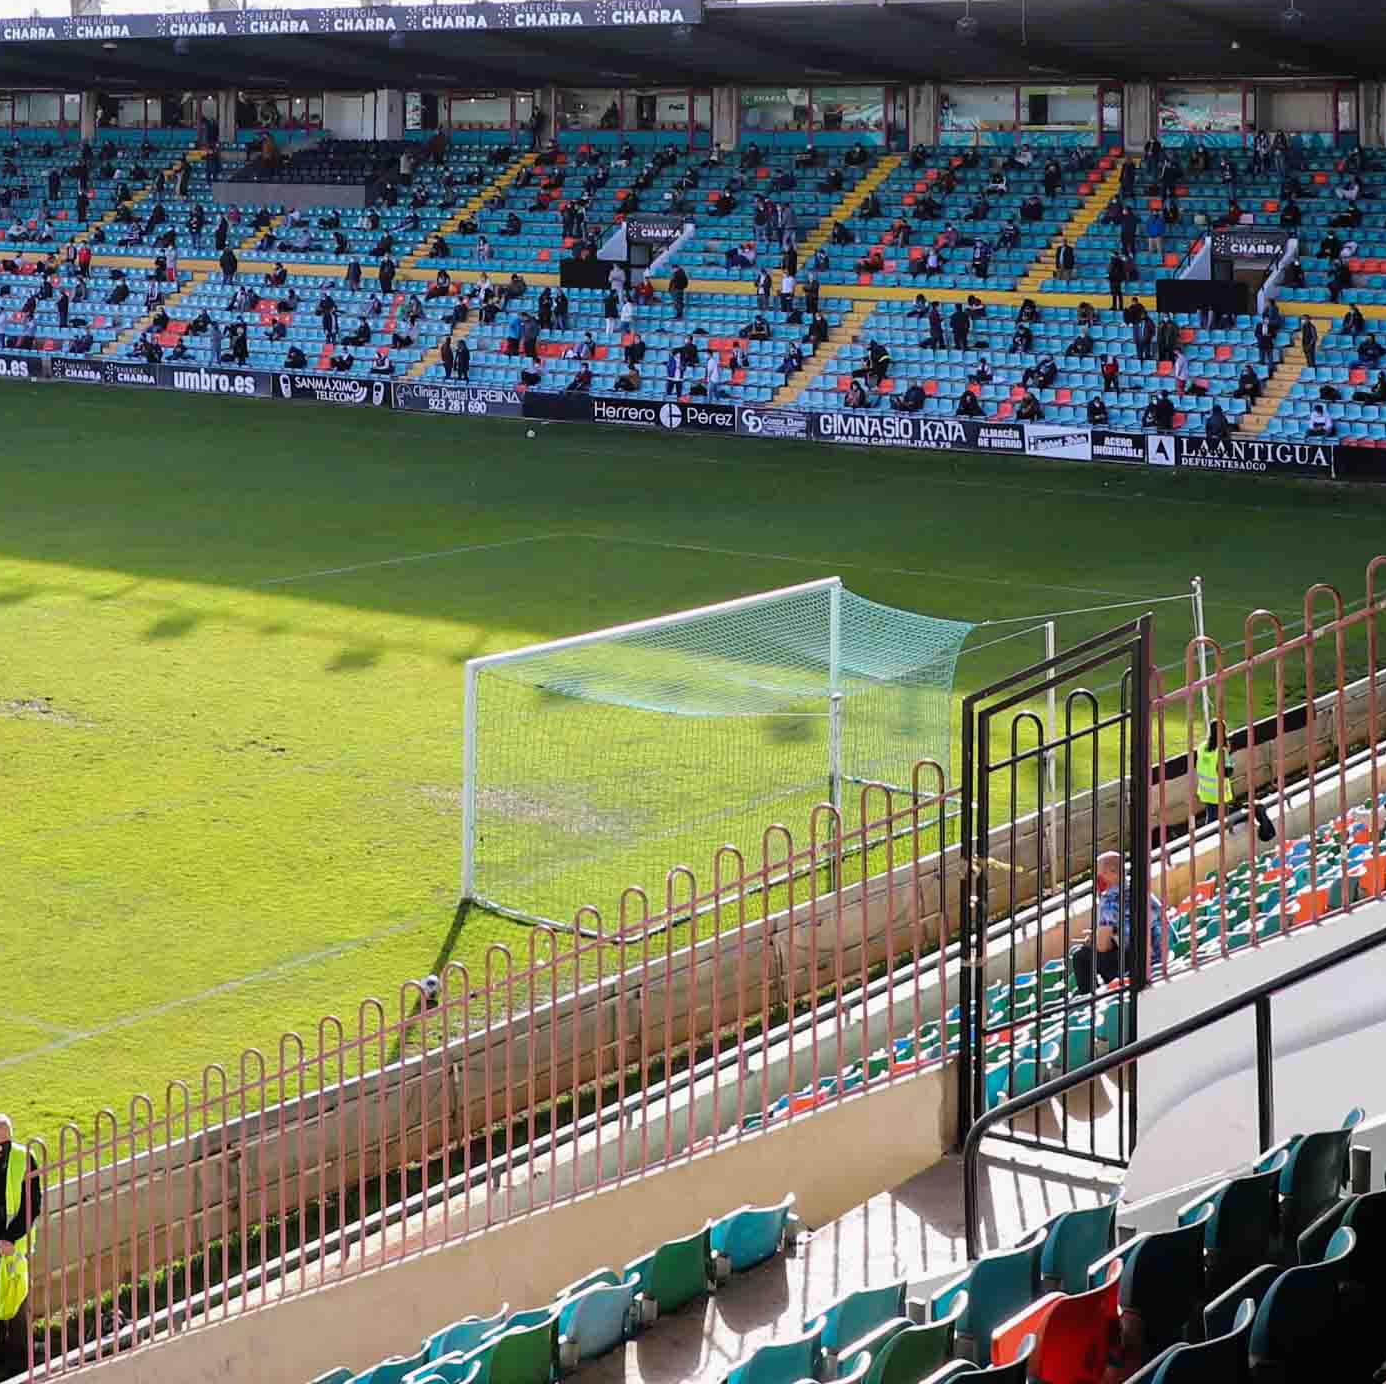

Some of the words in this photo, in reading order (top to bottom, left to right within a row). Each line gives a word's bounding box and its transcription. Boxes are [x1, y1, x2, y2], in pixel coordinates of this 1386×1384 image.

[422, 15, 487, 29] CHARRA
[515, 12, 583, 27] CHARRA
[613, 9, 684, 24] CHARRA
[76, 24, 130, 37] CHARRA
[170, 22, 227, 35] CHARRA
[250, 20, 309, 33] CHARRA
[334, 17, 396, 31] CHARRA
[4, 27, 55, 40] CHARRA
[641, 228, 680, 238] CHARRA
[1230, 244, 1284, 254] CHARRA
[65, 369, 101, 381] CHARRA
[117, 372, 156, 385] CHARRA
[173, 368, 256, 394] umbro.es
[315, 390, 356, 403] TELECOM
[441, 385, 468, 401] Dental
[428, 399, 446, 412] 923
[448, 400, 466, 413] 281
[468, 401, 487, 414] 690
[593, 400, 655, 422] Herrero
[686, 407, 734, 427] Pérez
[819, 414, 912, 439] GIMNASIO
[920, 420, 967, 442] KATA
[977, 437, 990, 447] DE
